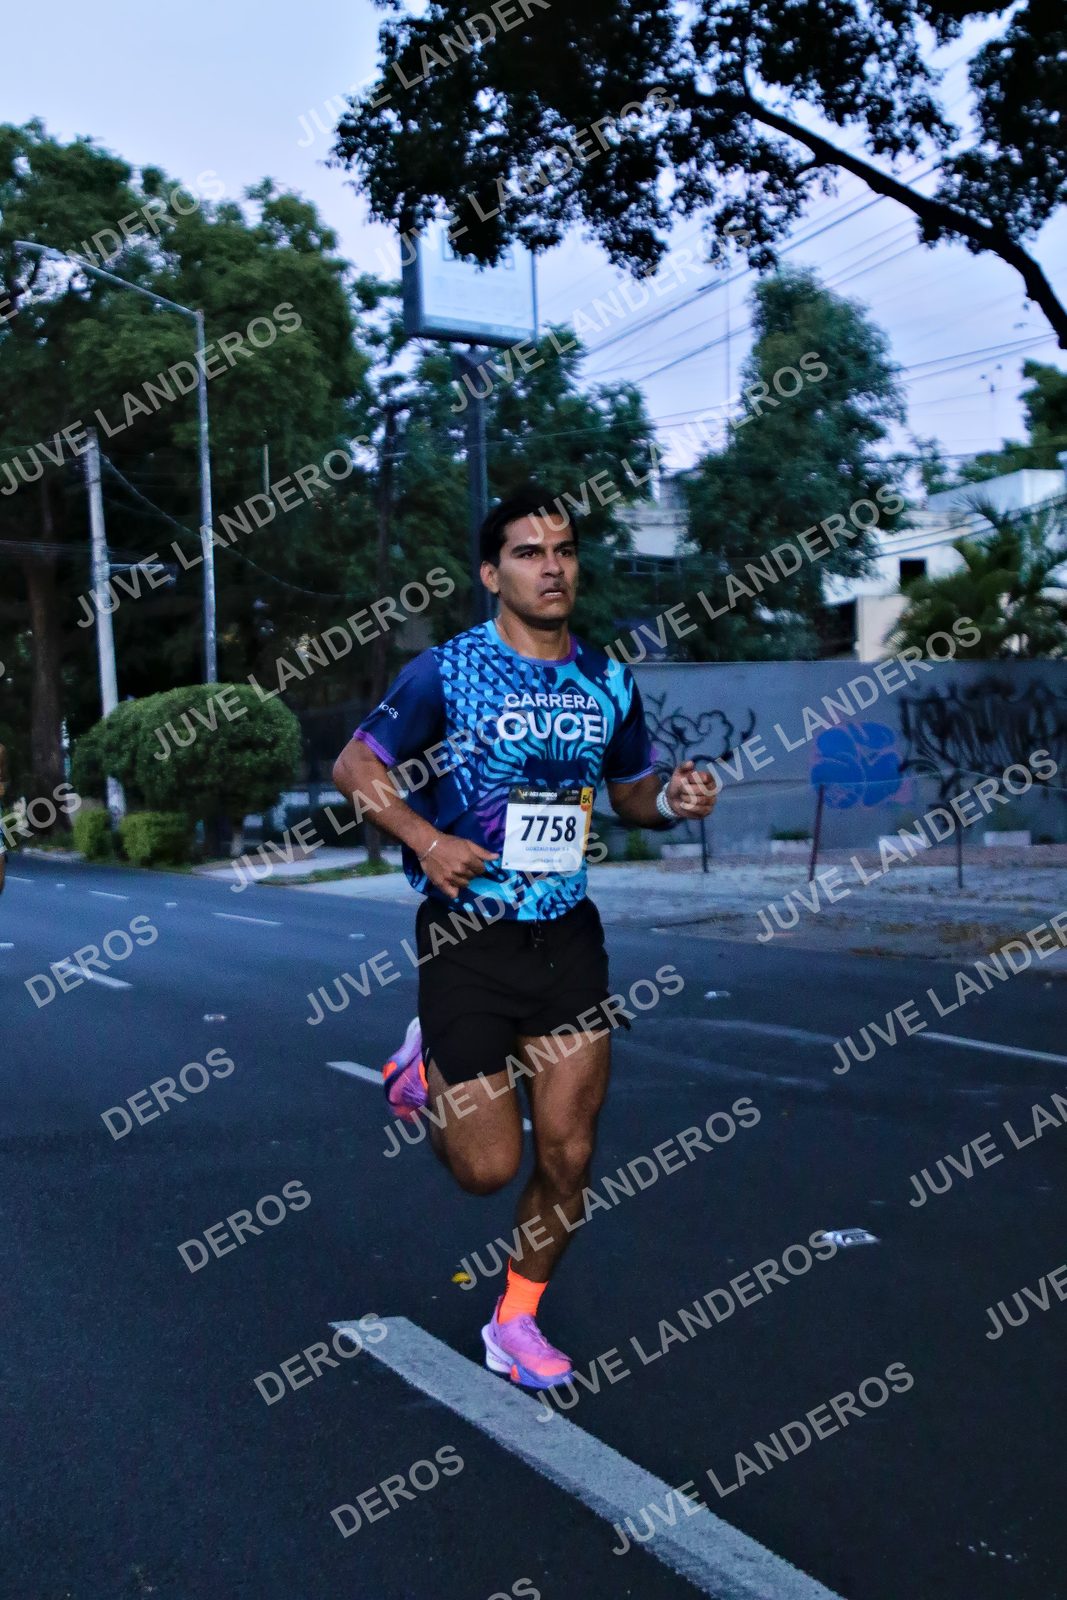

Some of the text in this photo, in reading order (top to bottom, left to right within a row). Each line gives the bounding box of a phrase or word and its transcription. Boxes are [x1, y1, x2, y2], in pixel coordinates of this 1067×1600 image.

[505, 693, 599, 710] CARRERA
[497, 712, 608, 744] CUCEI
[521, 815, 577, 842] 7758
